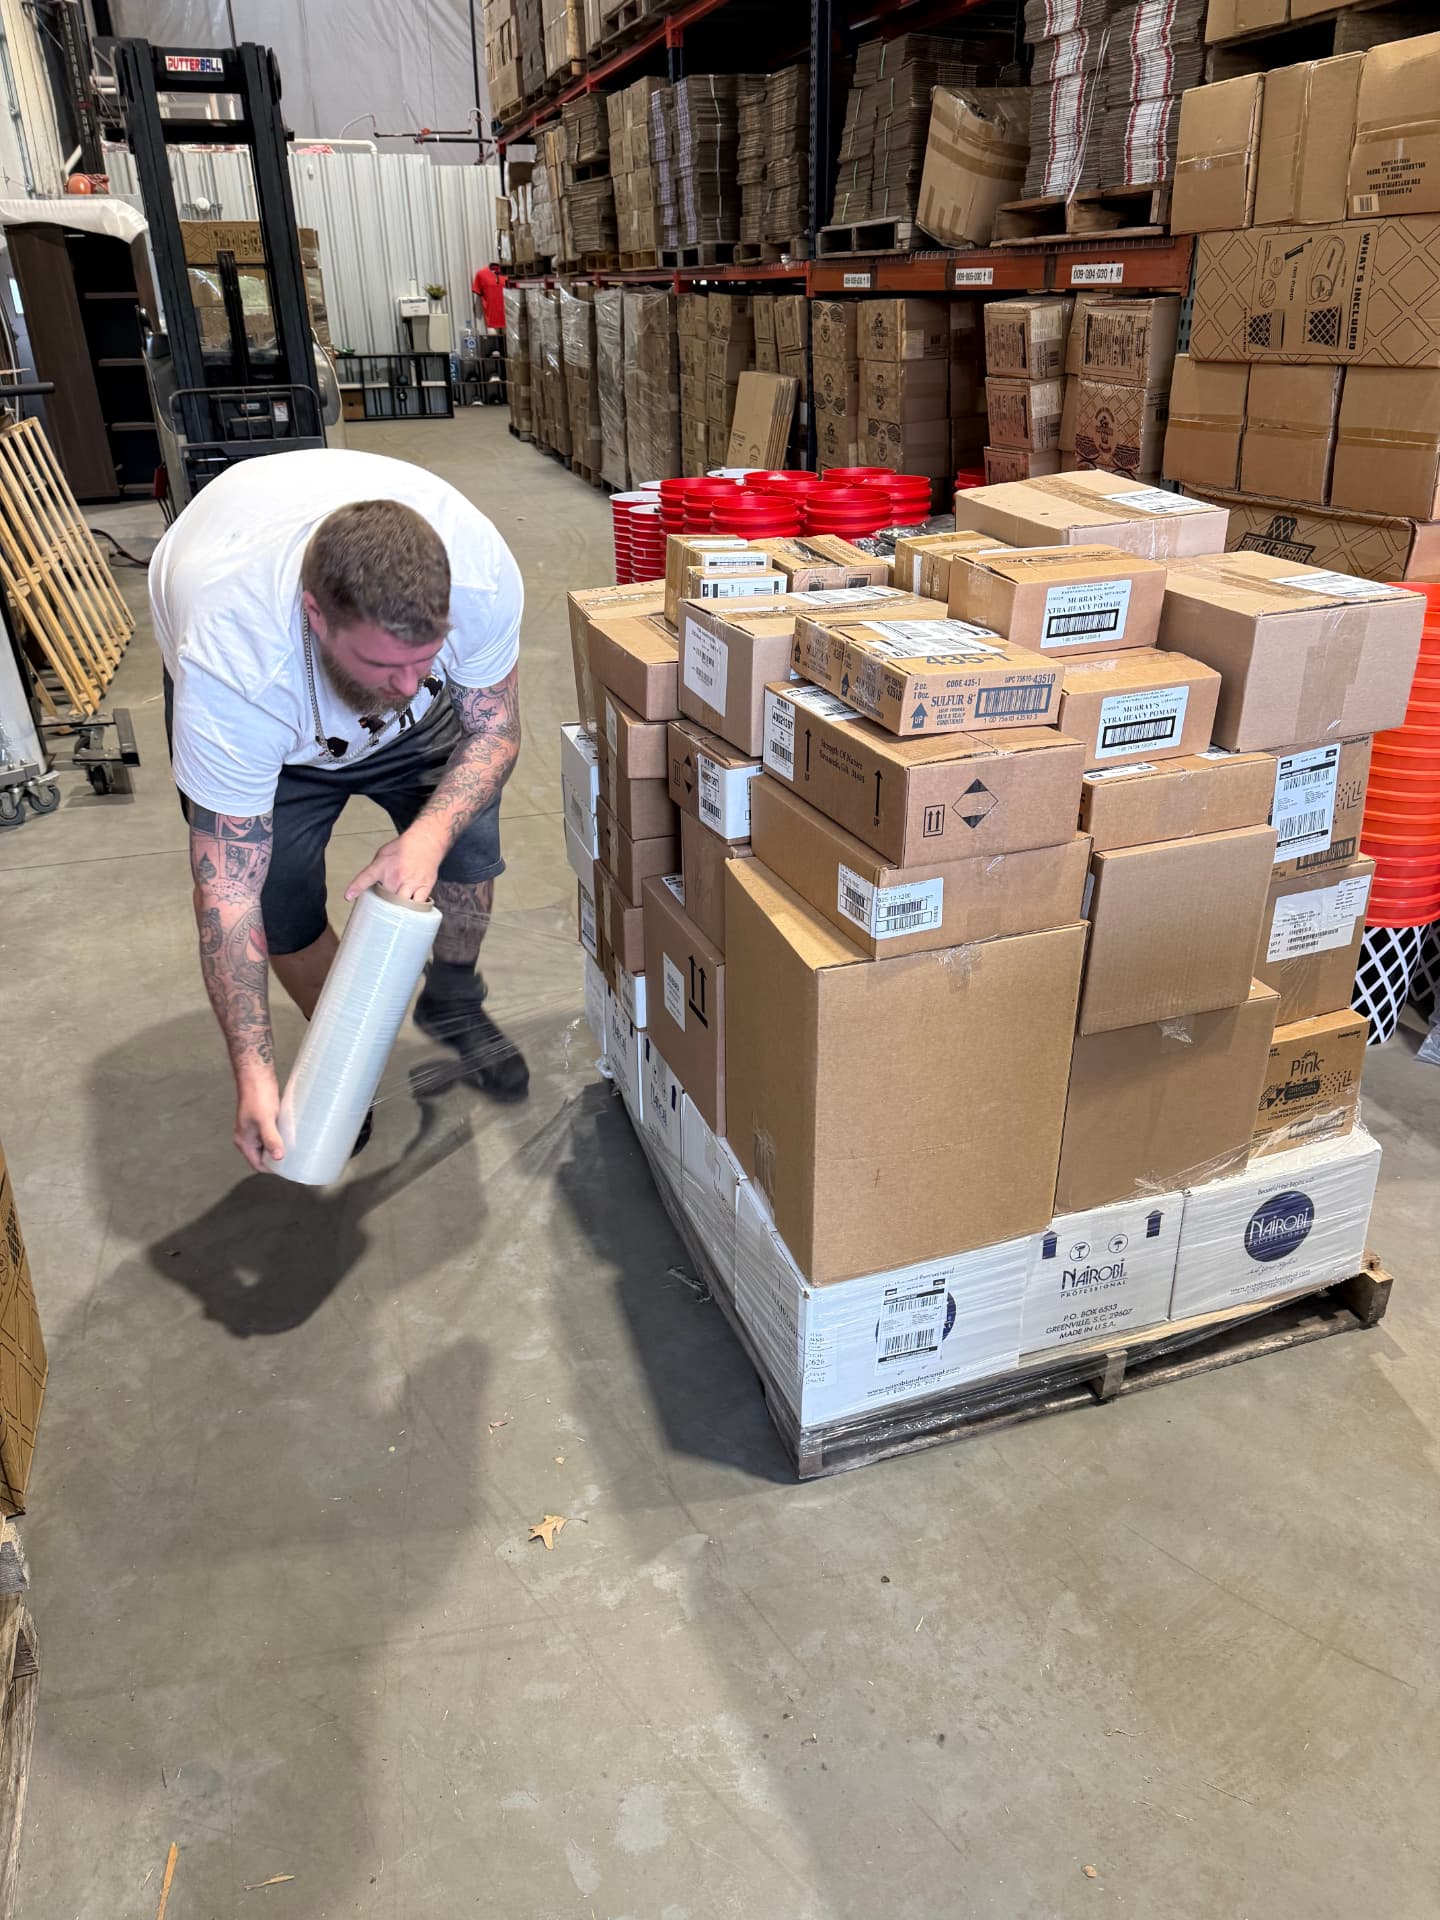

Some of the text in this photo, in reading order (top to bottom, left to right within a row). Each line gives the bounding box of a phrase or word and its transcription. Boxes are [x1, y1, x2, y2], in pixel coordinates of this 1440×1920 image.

[167, 57, 222, 71] PUTTERBALL
[1349, 232, 1371, 350] WHAT'S INCLUDED
[1067, 593, 1104, 603] MURRAY'S
[1047, 600, 1121, 615] XTRA HEAVY POMADE
[946, 679, 963, 688] CODE
[931, 695, 964, 707] SULFUR
[1123, 703, 1160, 713] MURRAY'S
[1102, 708, 1178, 725] XTRA HEAVY POMADE
[1290, 1053, 1321, 1077] Pink
[1060, 1281, 1127, 1298] PROFESSIONAL
[1080, 1307, 1098, 1318] BOX
[1098, 1303, 1118, 1315] 6533
[1109, 1308, 1133, 1320] 29607
[1059, 1327, 1082, 1339] MADE
[1083, 1325, 1093, 1333] IN
